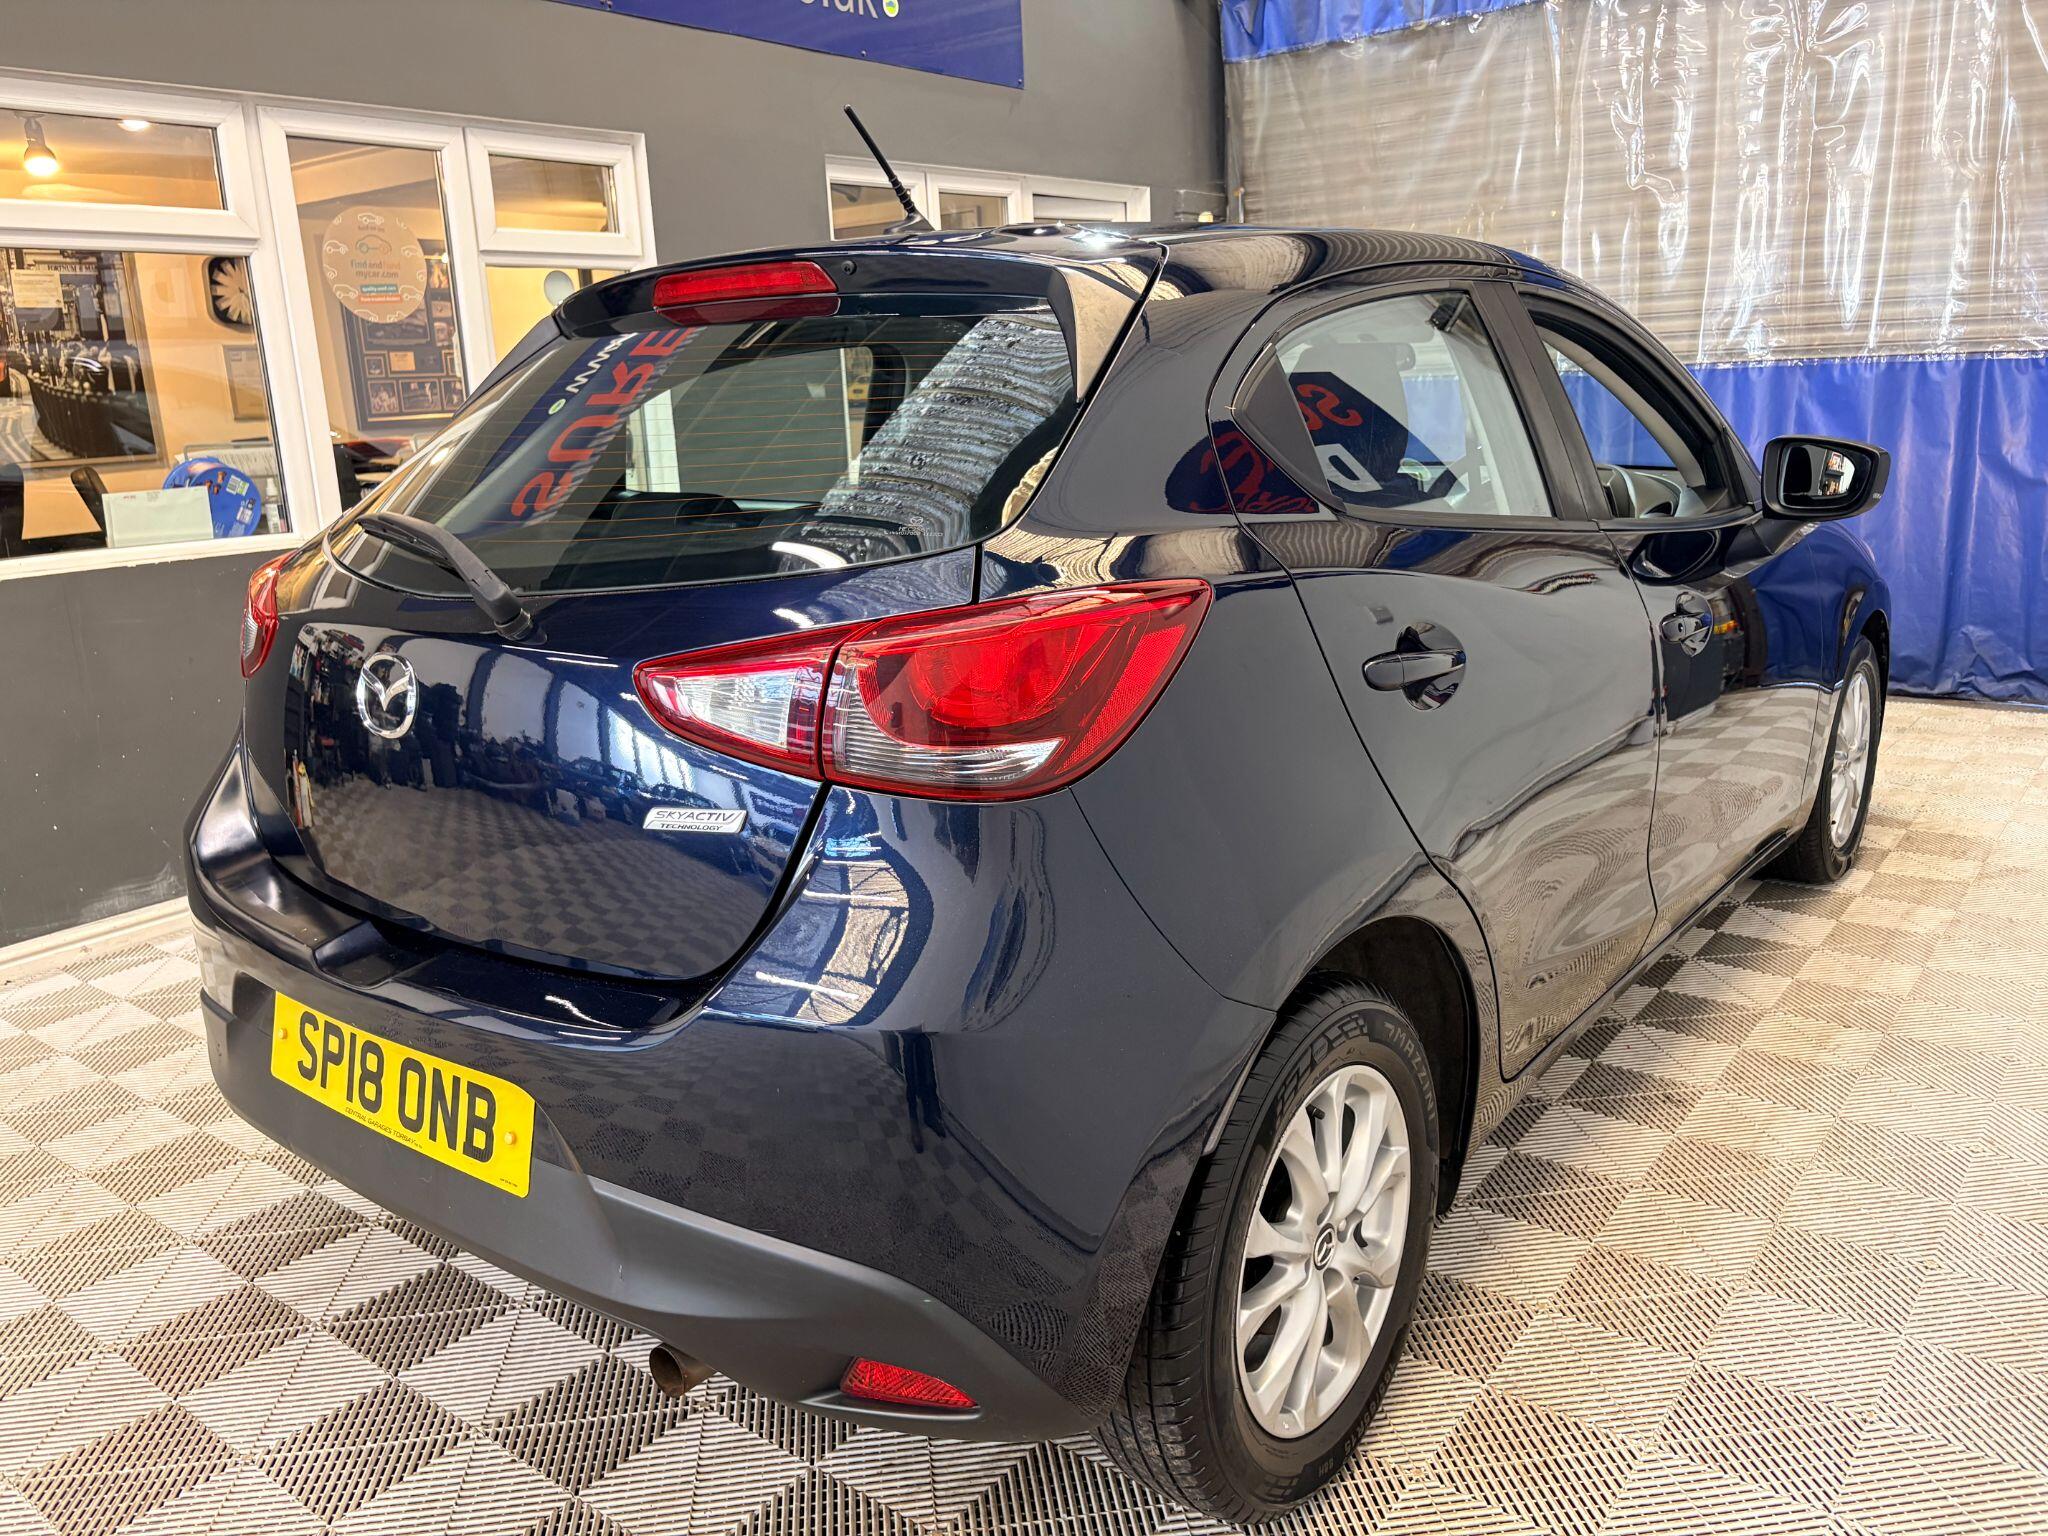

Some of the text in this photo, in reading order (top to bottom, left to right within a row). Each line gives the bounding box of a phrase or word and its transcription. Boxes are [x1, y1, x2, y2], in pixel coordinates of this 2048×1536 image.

[654, 810, 735, 821] SKYACTIV
[660, 823, 723, 831] TECHNOLOGY
[298, 1010, 497, 1163] SP18 ONB
[1395, 1022, 1435, 1121] MAZZINI
[345, 1107, 417, 1144] CENTRAL GARAGES TORBAY
